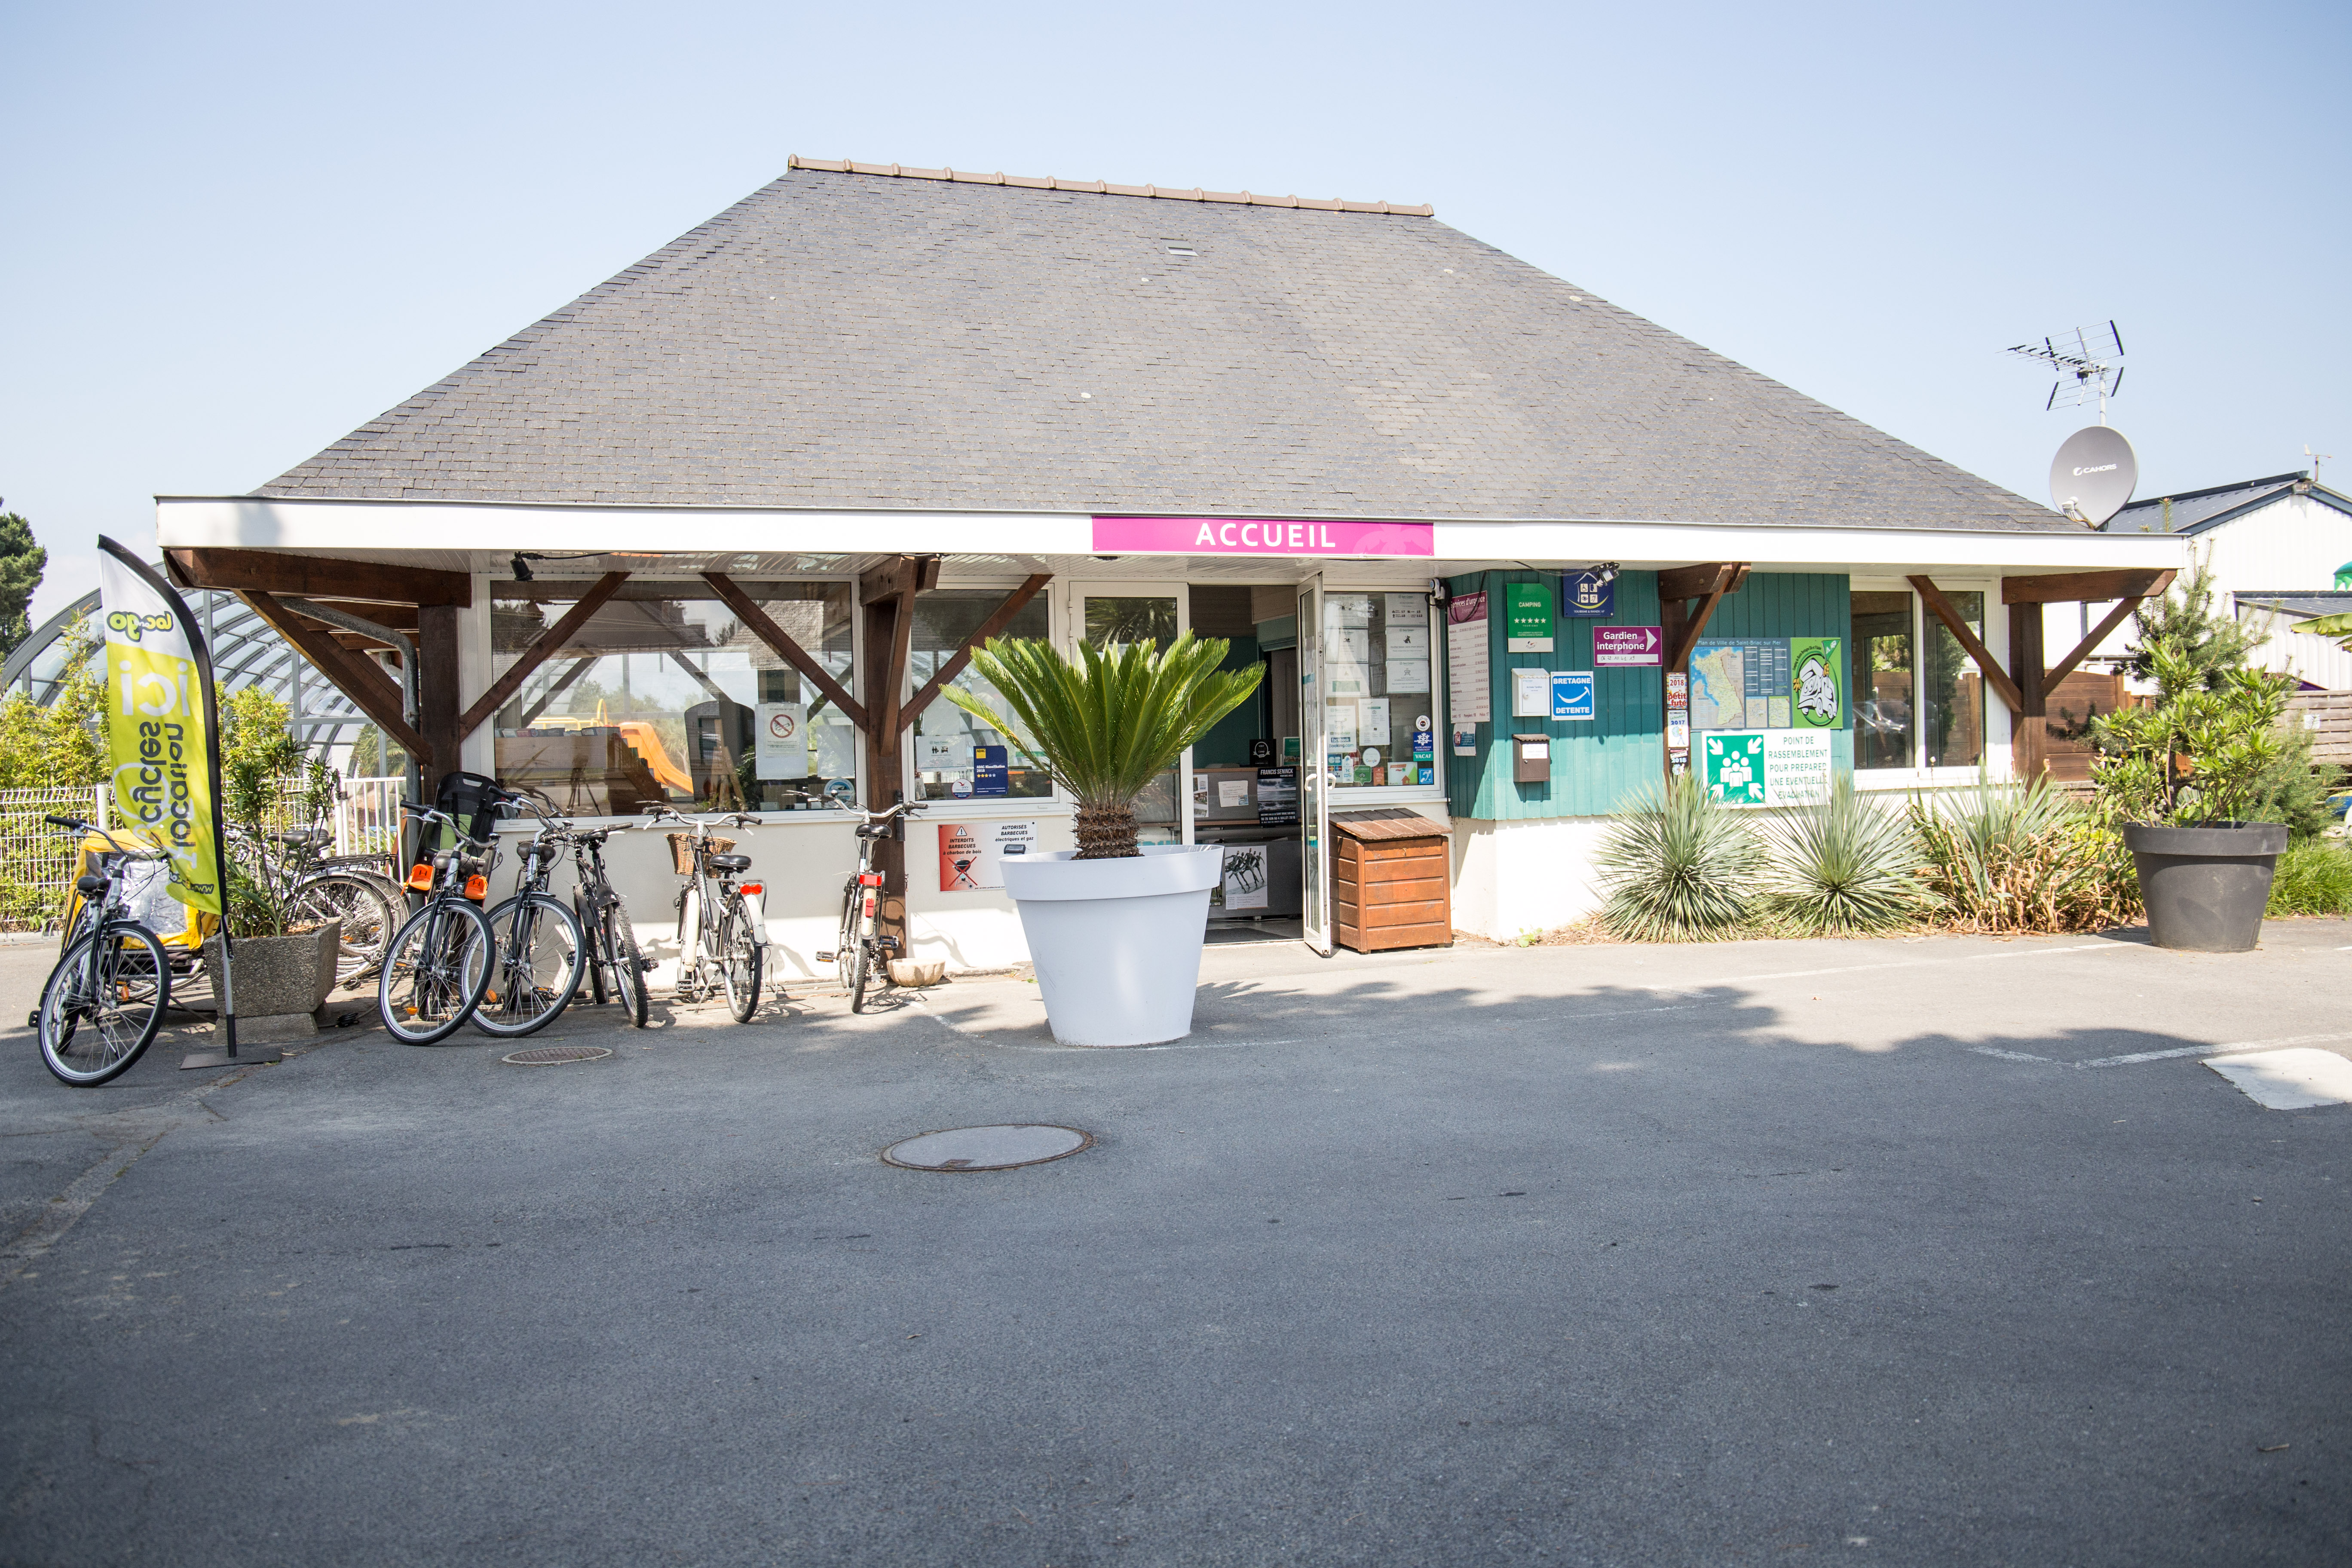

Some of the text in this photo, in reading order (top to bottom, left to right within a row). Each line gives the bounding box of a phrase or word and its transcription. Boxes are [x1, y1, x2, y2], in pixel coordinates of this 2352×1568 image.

[2083, 464, 2117, 473] CAHORS
[1195, 523, 1335, 547] ACCUEIL
[1603, 631, 1638, 640] Gardien
[1597, 642, 1645, 652] interphone
[1769, 749, 1828, 759] RASSEMBLEMENT
[1770, 764, 1788, 772] POUR
[1770, 778, 1783, 786] UNE
